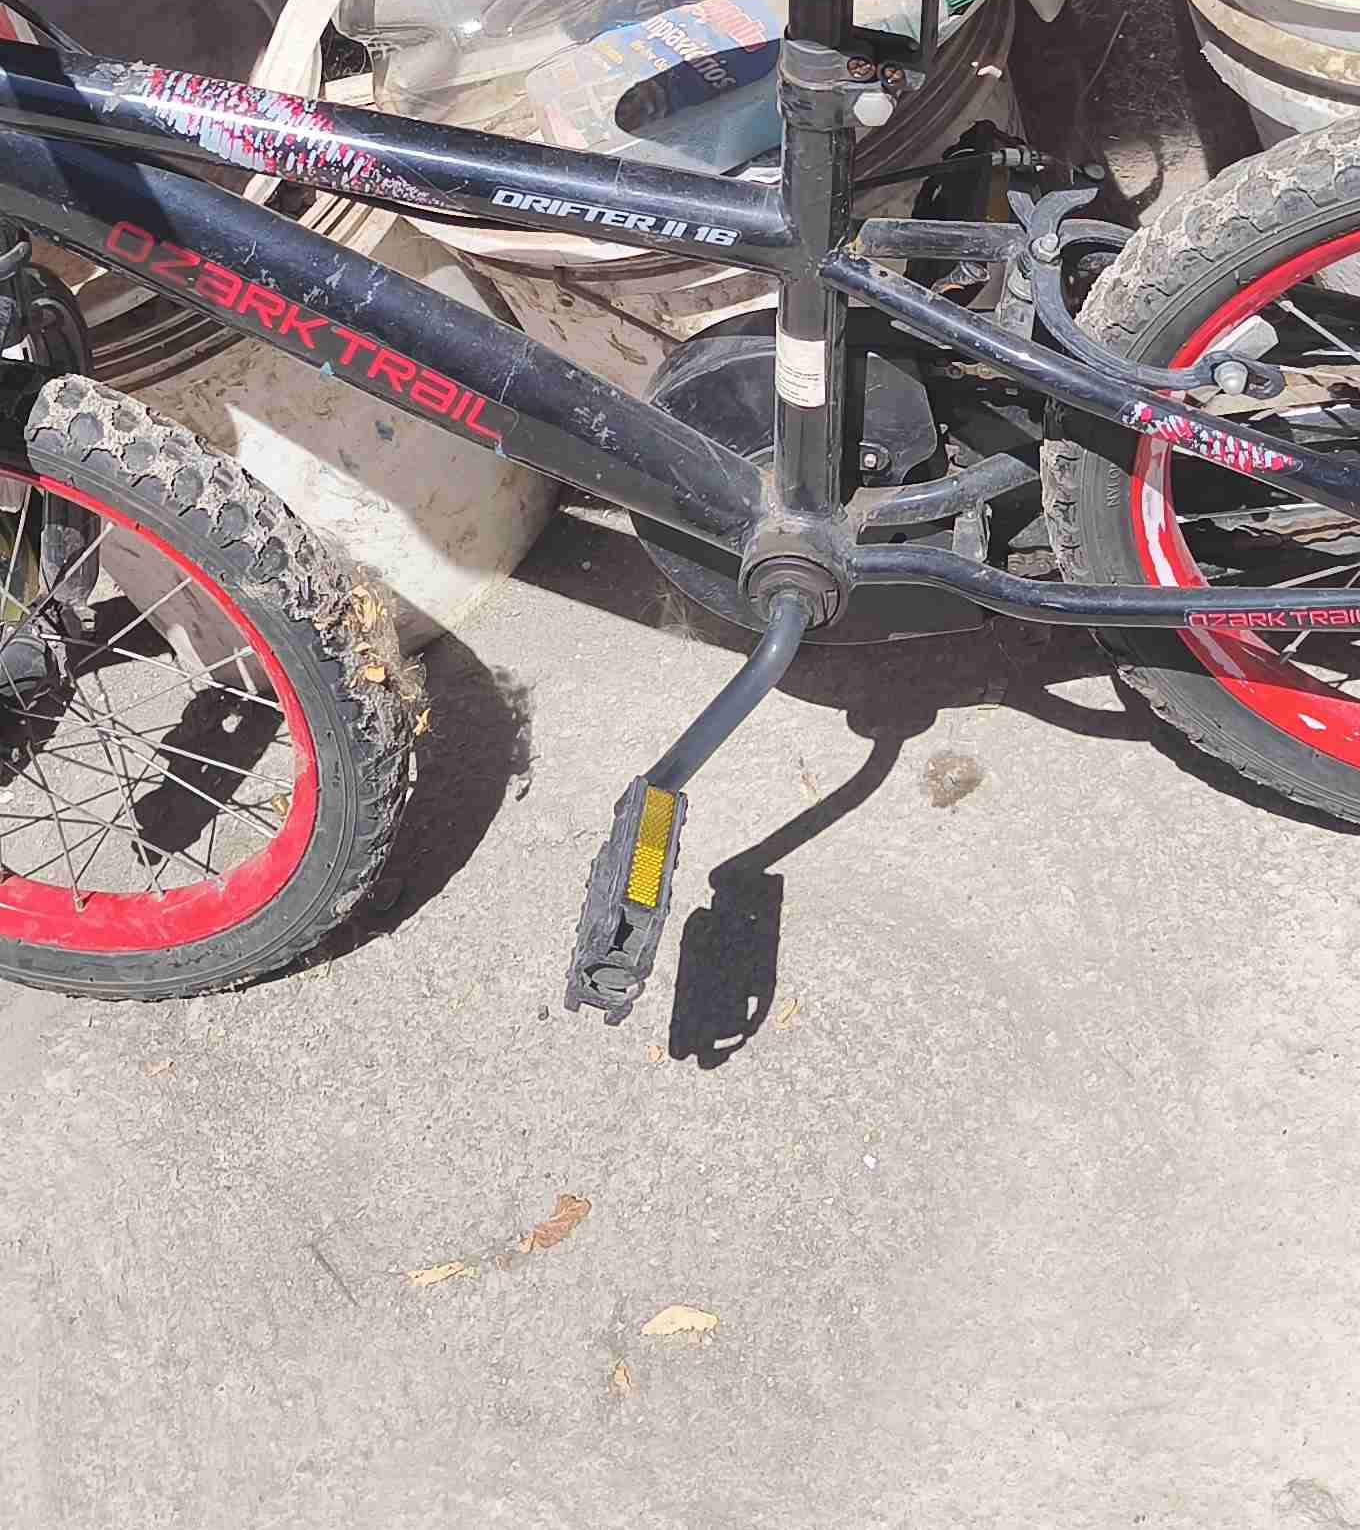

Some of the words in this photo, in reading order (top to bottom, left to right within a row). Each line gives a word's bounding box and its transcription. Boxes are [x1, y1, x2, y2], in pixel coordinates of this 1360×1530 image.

[490, 188, 657, 233] DRIFTER
[693, 225, 739, 248] 16
[103, 220, 331, 350] OZARK
[333, 327, 504, 442] TRAIL
